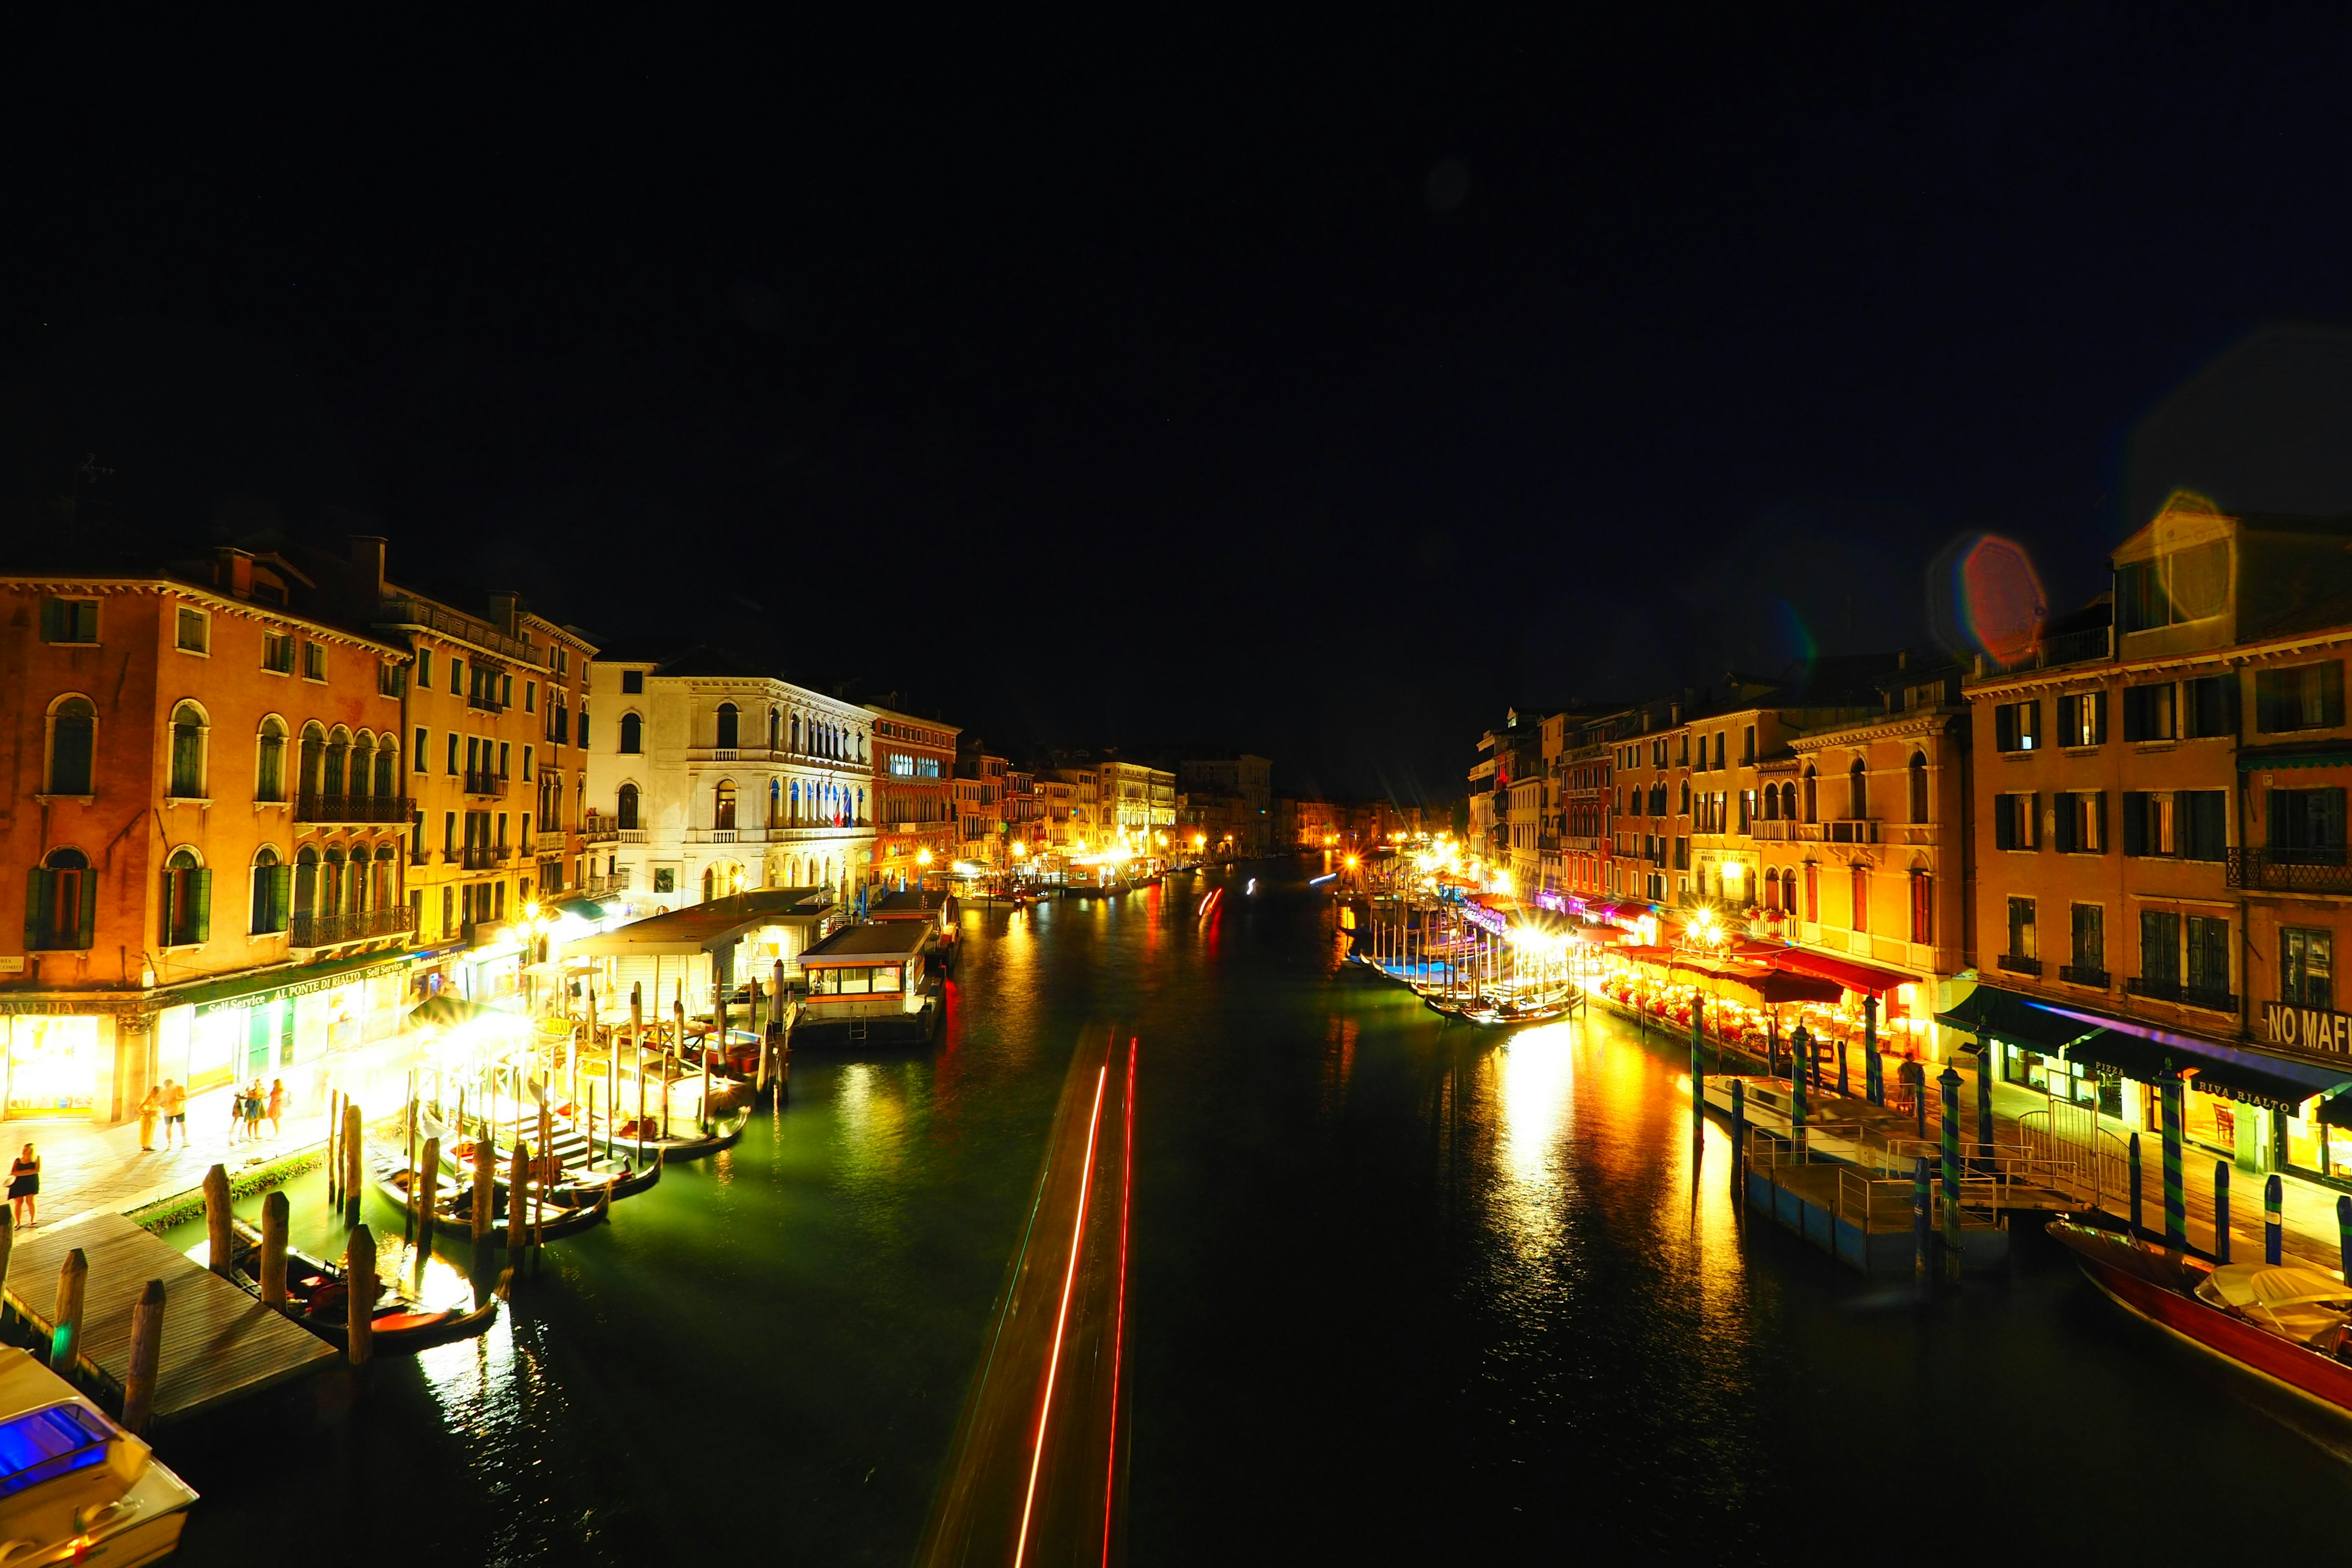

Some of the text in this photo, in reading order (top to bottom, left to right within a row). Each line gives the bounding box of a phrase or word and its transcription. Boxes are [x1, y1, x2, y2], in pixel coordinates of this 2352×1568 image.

[208, 962, 404, 1014] Self Service AL PONTE DI RIALTO Self Service
[0, 1001, 75, 1014] AVENA
[550, 1020, 567, 1032] TAXI
[2269, 1005, 2296, 1044] NO
[2095, 1061, 2124, 1076] PIZZA
[2199, 1081, 2290, 1113] RIVA RIALTO
